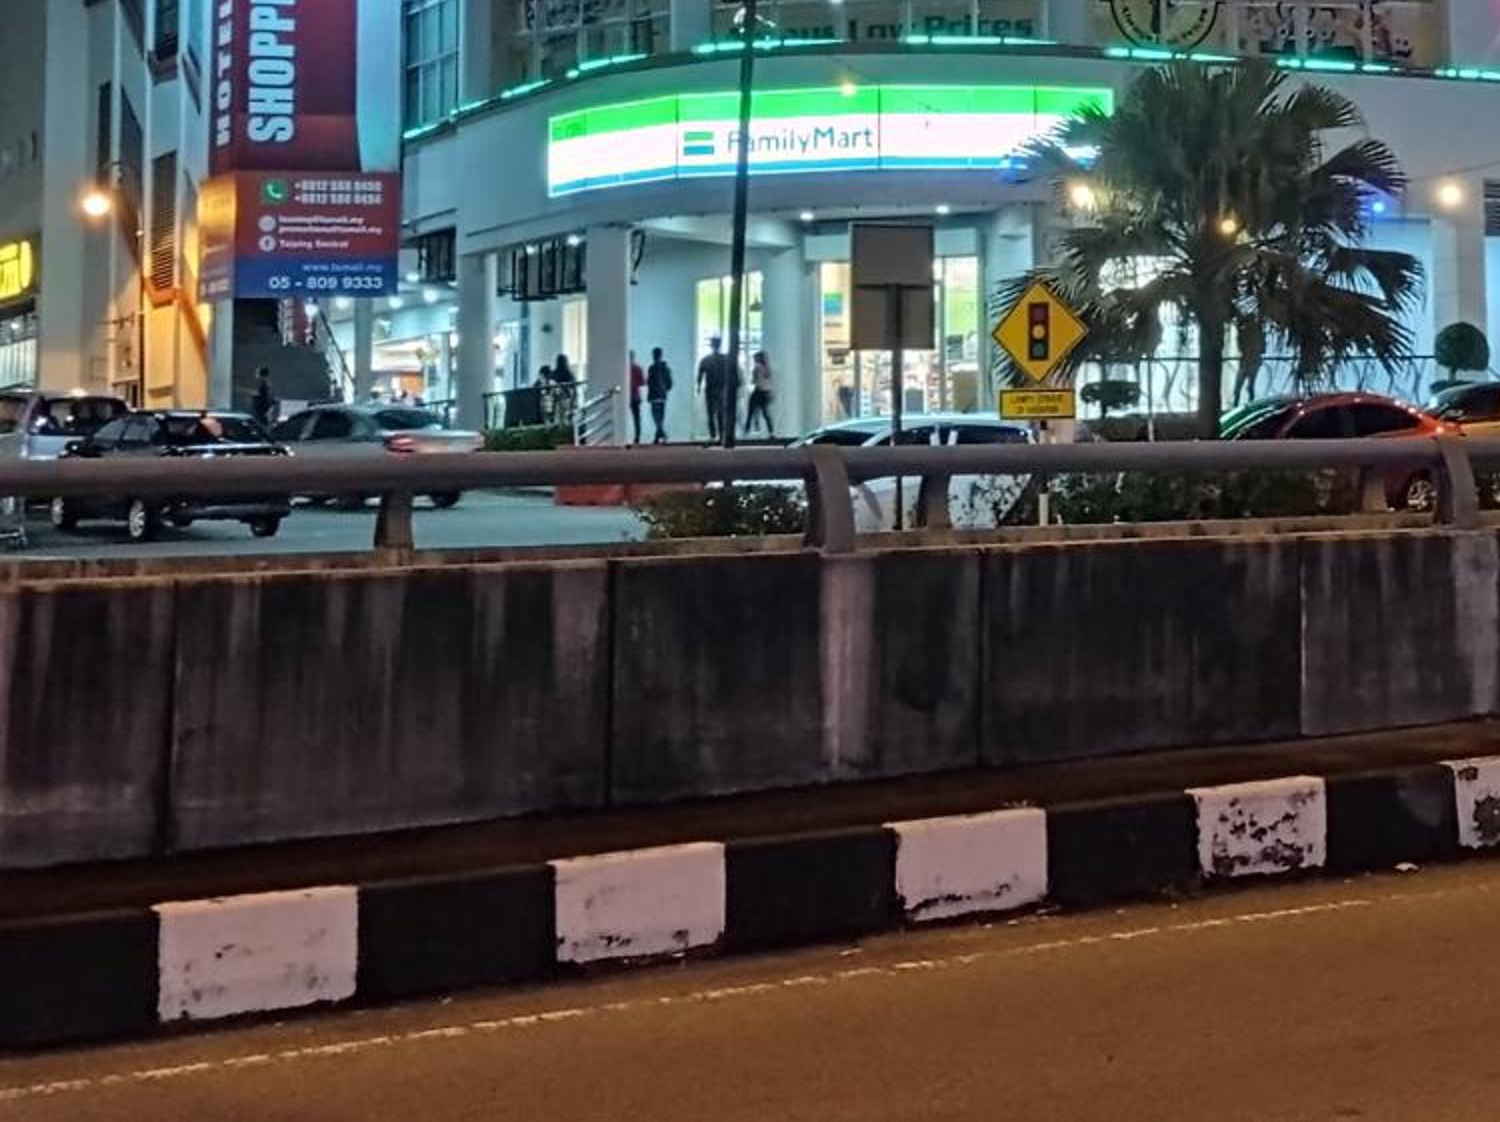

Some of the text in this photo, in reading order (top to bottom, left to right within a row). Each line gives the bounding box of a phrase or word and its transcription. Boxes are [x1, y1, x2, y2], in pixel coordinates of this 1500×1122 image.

[727, 126, 874, 154] FamilyMart
[268, 277, 290, 289] 05
[306, 277, 338, 289] 809
[342, 277, 383, 289] 9333
